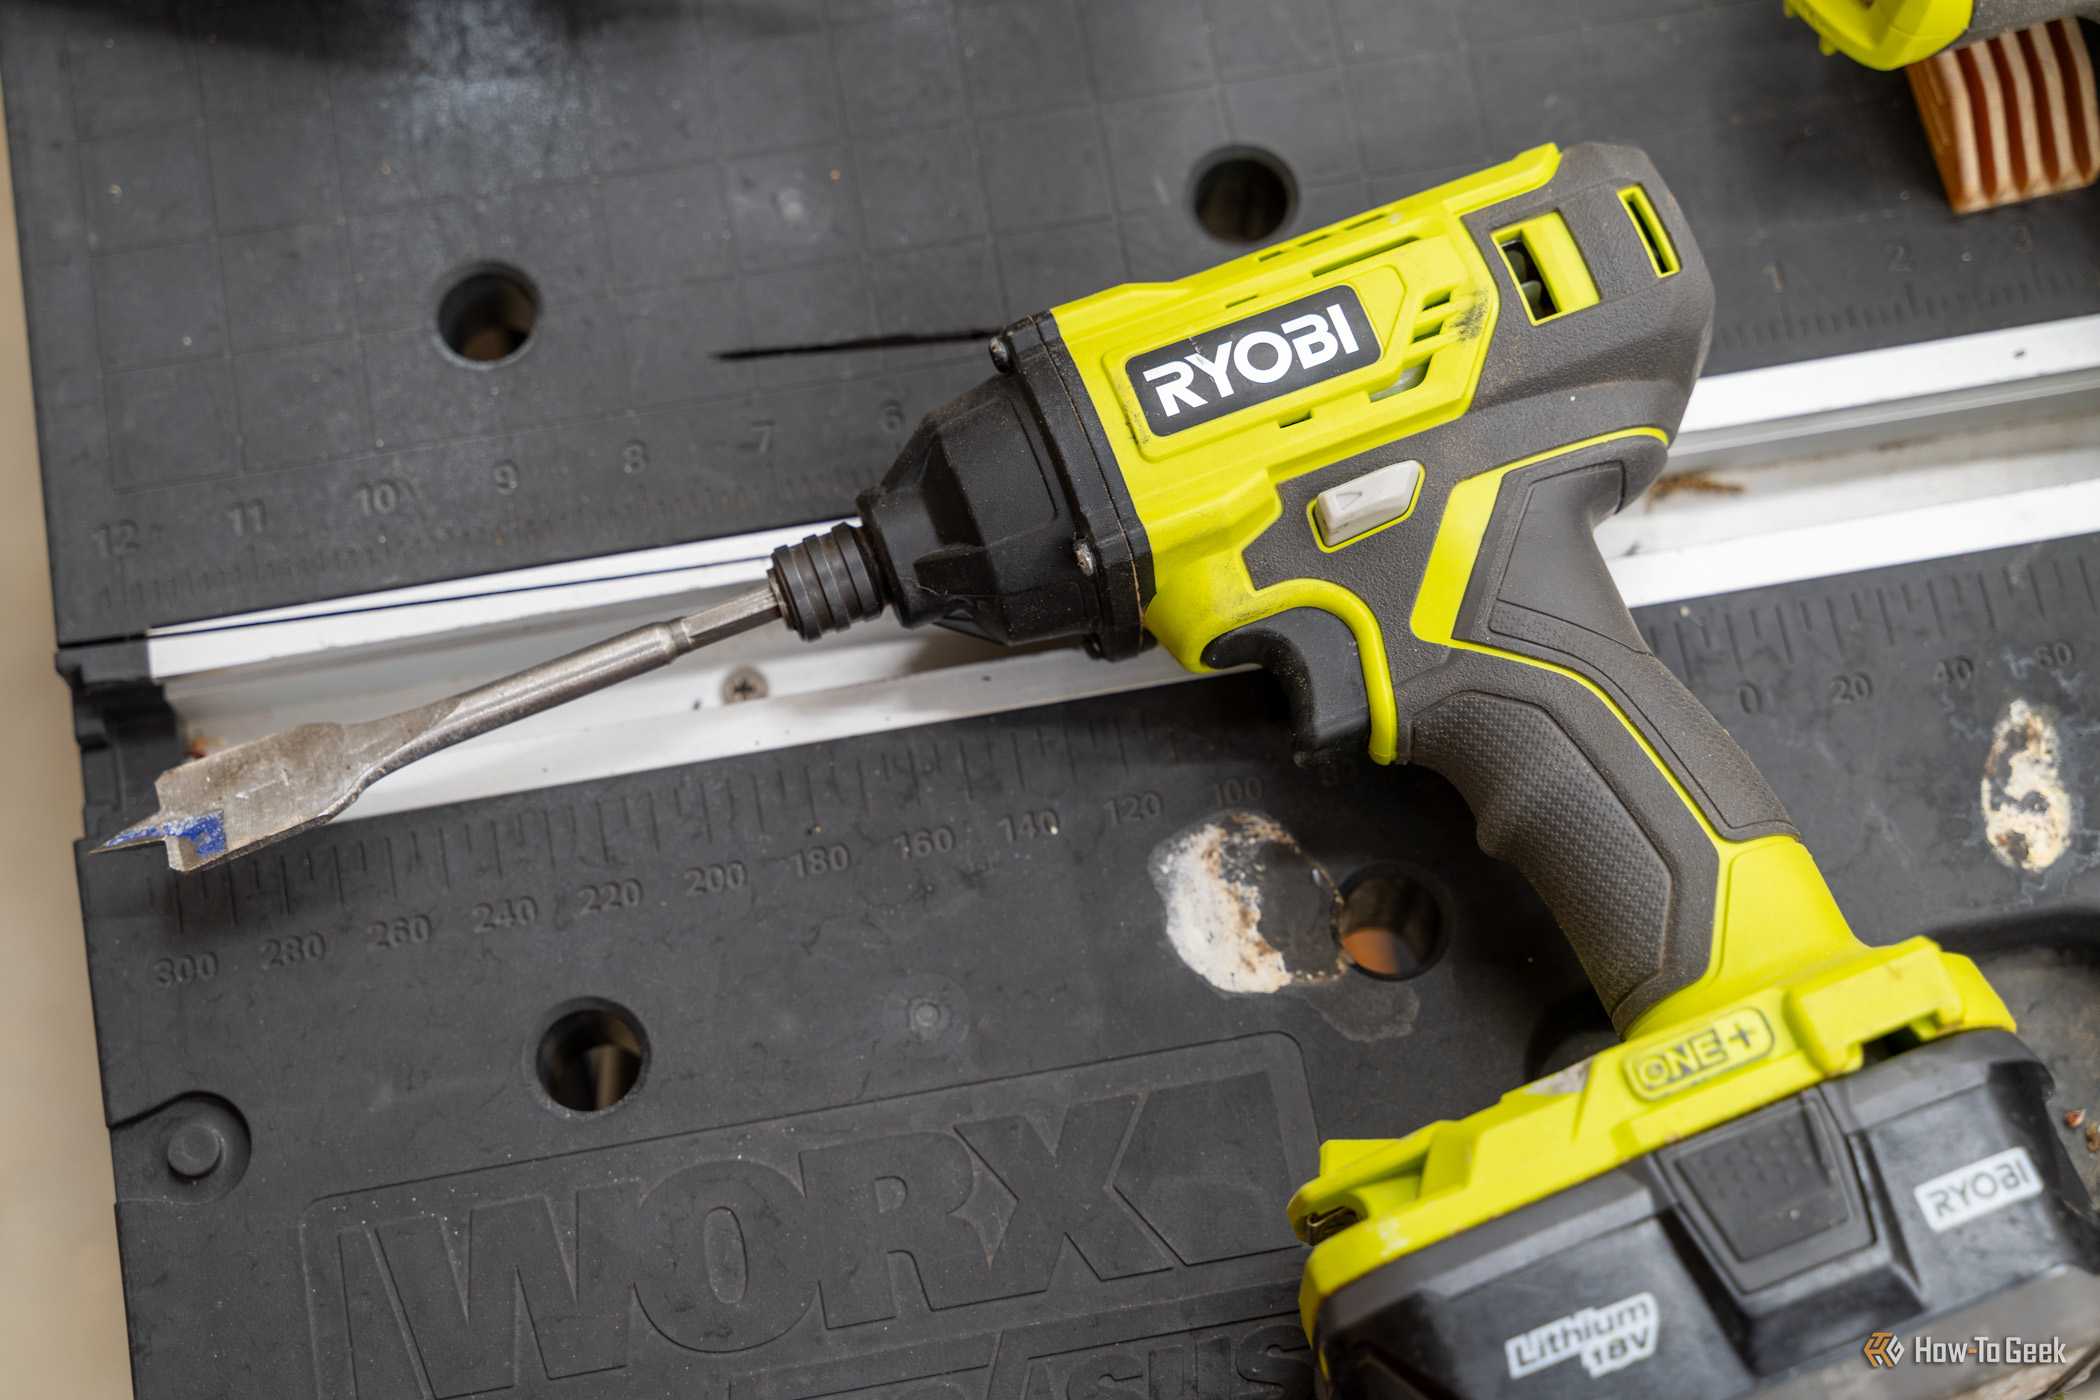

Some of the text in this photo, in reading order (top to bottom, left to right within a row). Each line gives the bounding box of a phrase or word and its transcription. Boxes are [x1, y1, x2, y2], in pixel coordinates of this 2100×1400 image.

[1143, 304, 1359, 416] RYOBI
[92, 519, 140, 558] 12
[227, 498, 267, 536] 11
[357, 482, 398, 517] 10
[495, 459, 517, 495] 9
[625, 439, 648, 473] 8
[752, 421, 775, 454] 7
[1738, 681, 1762, 714] 0
[1832, 672, 1873, 703] 20
[156, 950, 219, 987] 300
[263, 930, 326, 969] 280
[368, 913, 432, 952] 260
[473, 895, 538, 934] 240
[577, 878, 643, 916] 220
[684, 860, 748, 897] 200
[796, 843, 850, 878] 180
[900, 825, 956, 860] 160
[1001, 808, 1061, 843] 140
[1103, 791, 1163, 826] 120
[1928, 1160, 2030, 1217] RYOBI
[375, 1092, 1173, 1400] WORX
[1515, 1302, 1649, 1366] Lithium
[1593, 1327, 1649, 1365] 18V
